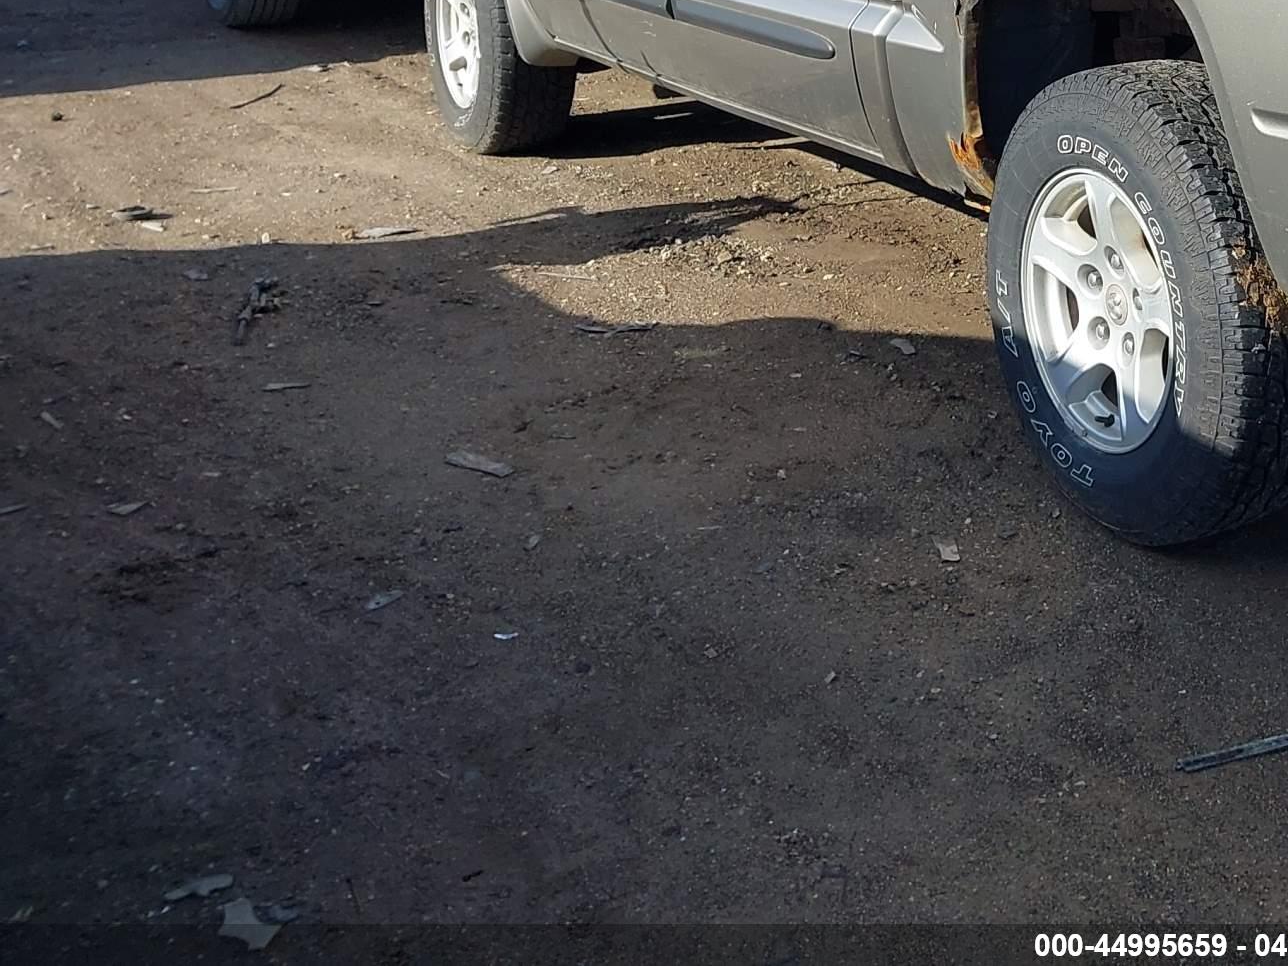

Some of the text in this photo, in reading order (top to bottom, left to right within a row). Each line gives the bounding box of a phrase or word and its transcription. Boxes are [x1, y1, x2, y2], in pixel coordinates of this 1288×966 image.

[995, 269, 1020, 357] A/T
[1056, 134, 1186, 417] OPEN COUNTRY
[1015, 380, 1095, 488] TOYO
